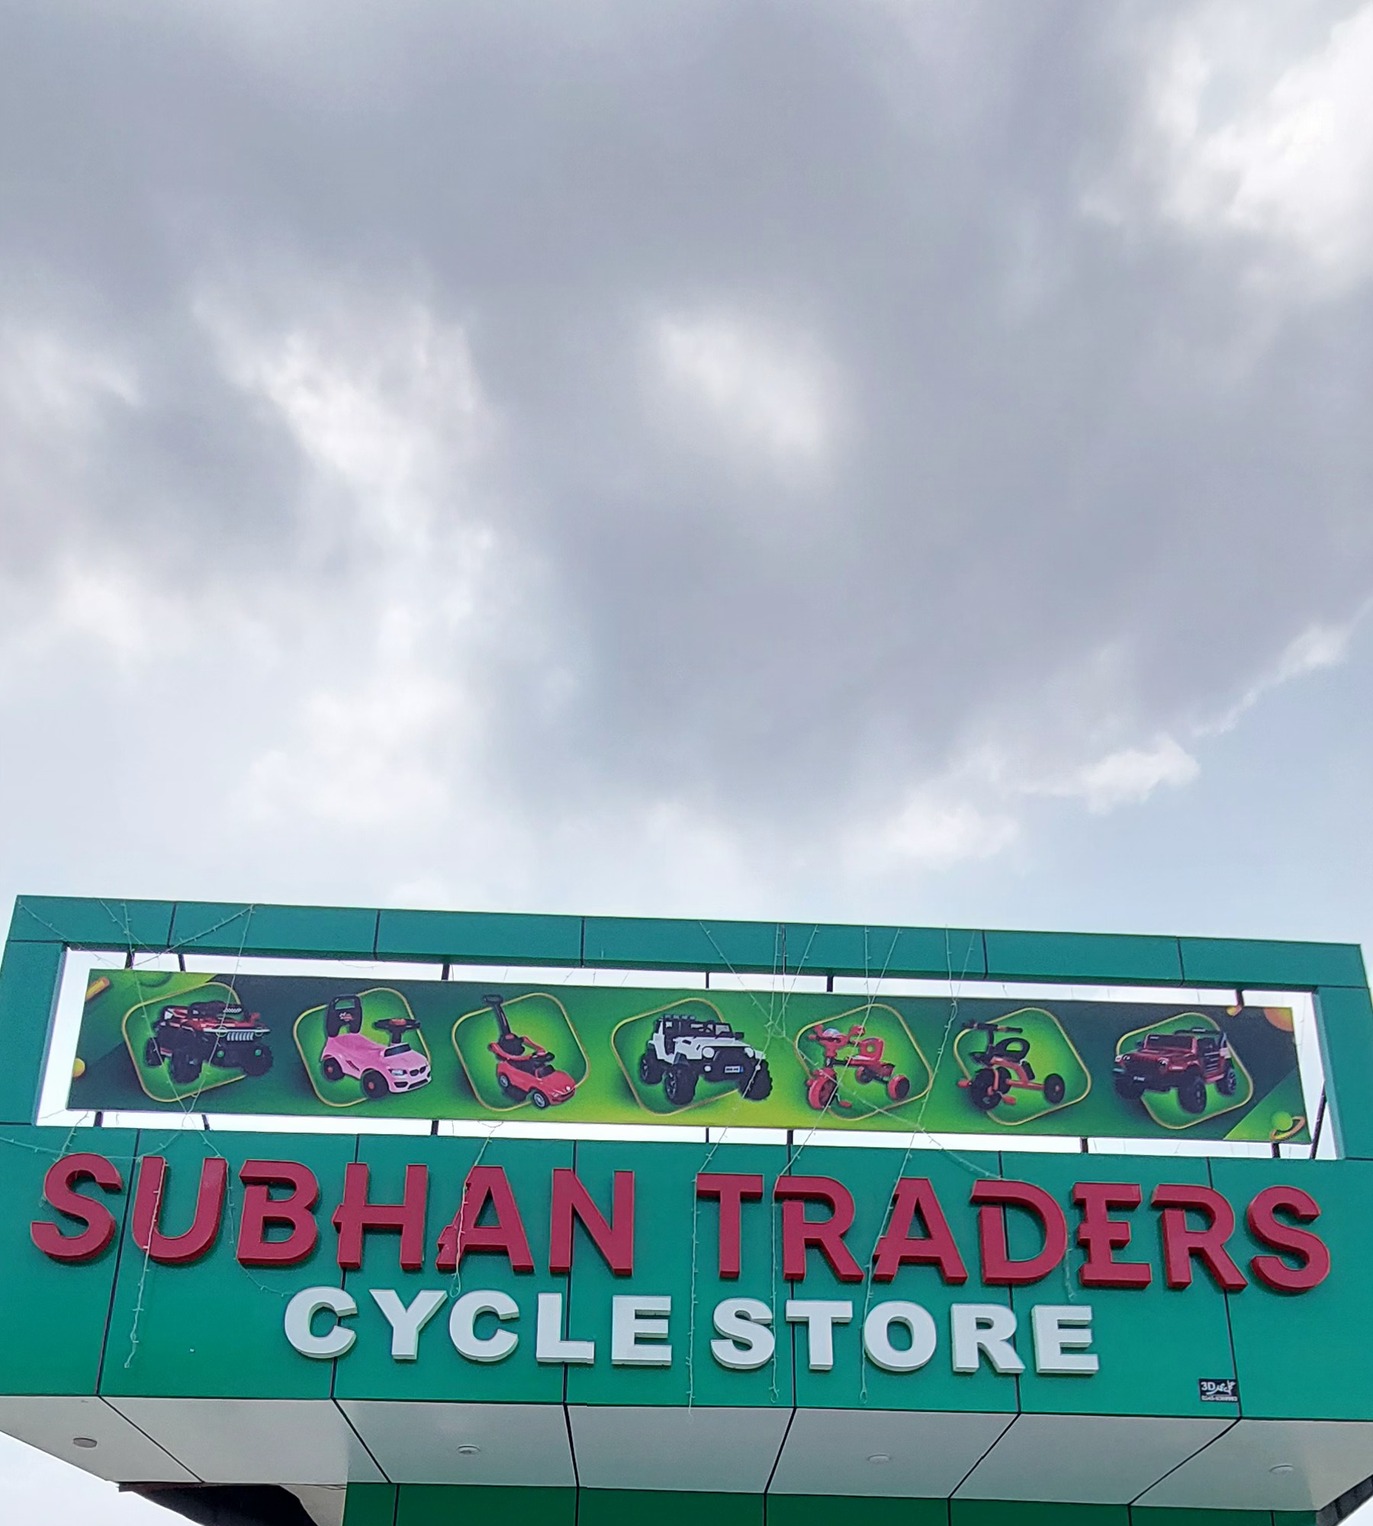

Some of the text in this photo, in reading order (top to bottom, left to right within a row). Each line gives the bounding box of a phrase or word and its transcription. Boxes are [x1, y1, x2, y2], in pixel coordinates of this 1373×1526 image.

[30, 1153, 1331, 1293] SUBHAN TRADERS
[283, 1286, 1099, 1374] CYCLE STORE
